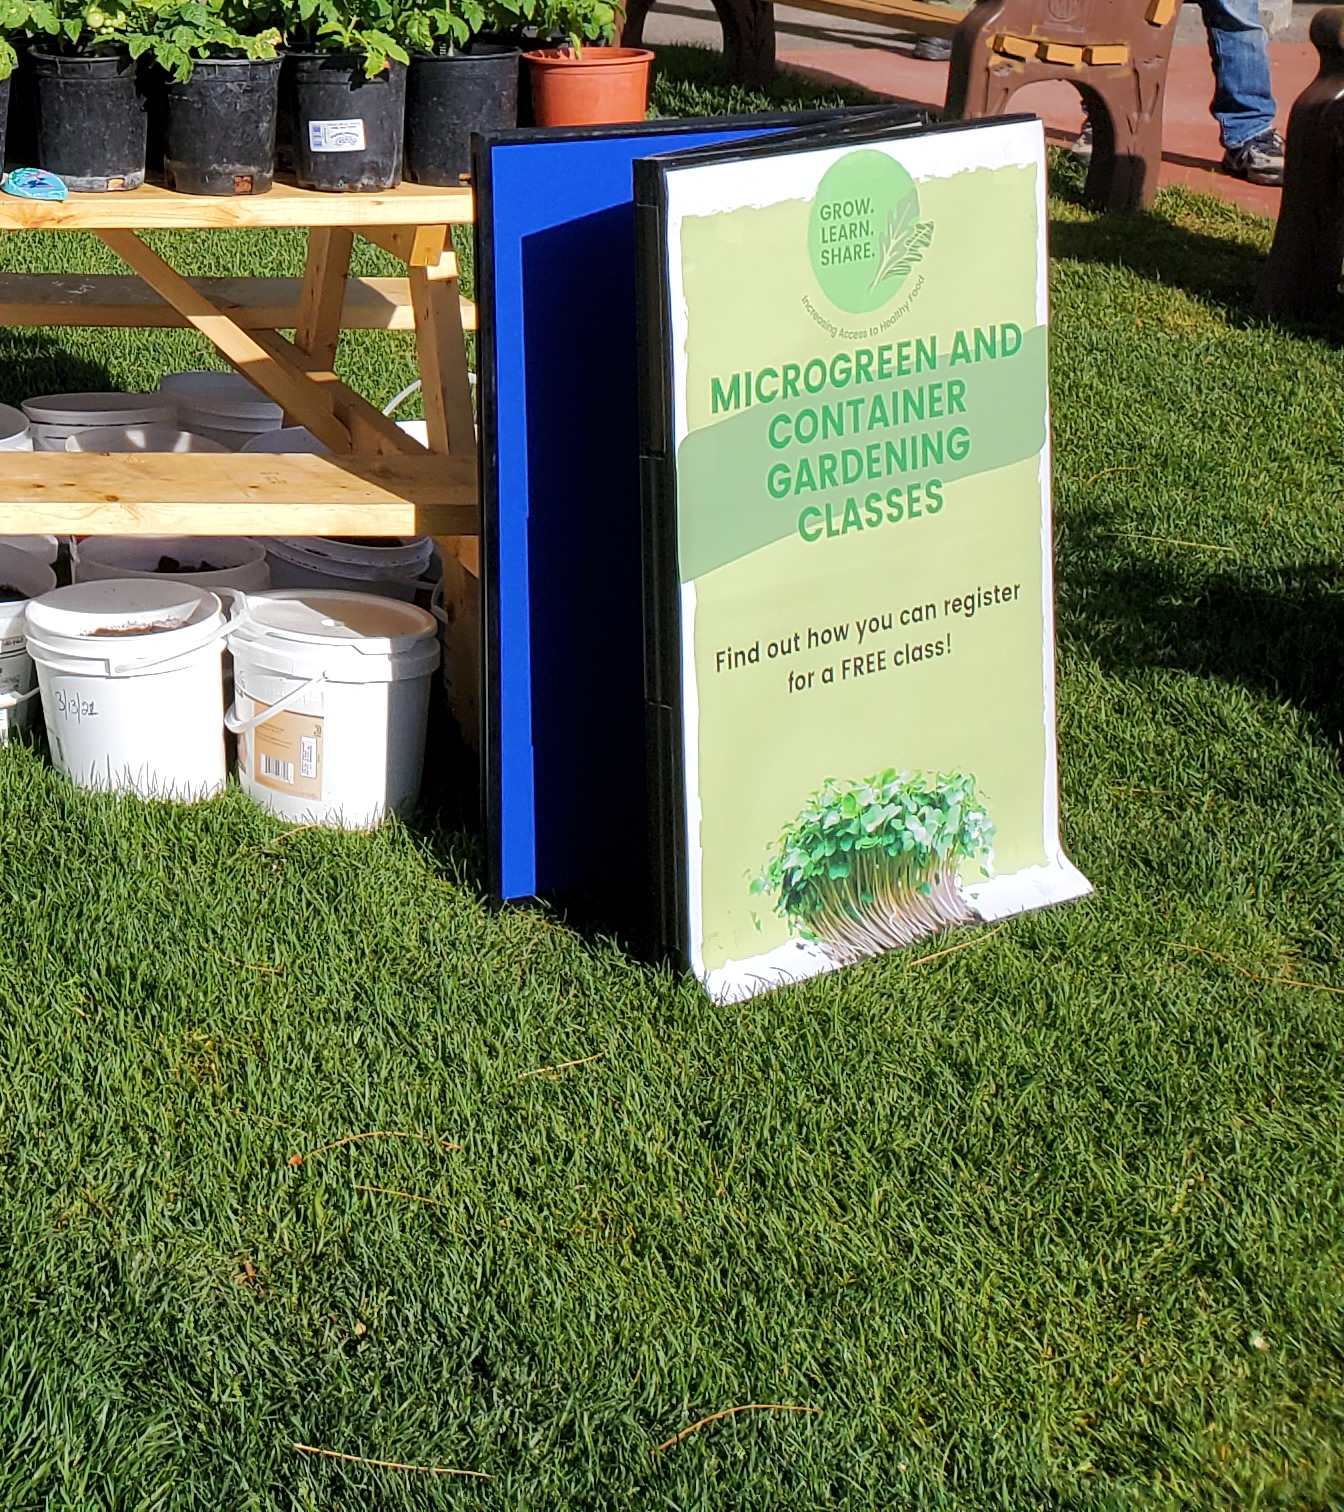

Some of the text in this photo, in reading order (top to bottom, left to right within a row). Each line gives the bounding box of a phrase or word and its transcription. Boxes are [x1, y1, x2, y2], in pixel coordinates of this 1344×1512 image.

[819, 197, 874, 221] GROW.
[821, 220, 874, 244] LEARN.
[820, 242, 875, 266] SHARE.
[801, 275, 926, 340] Increasing Access to Healthy Food
[710, 322, 1023, 415] MICROGREEN AND
[768, 378, 967, 450] CONTAINER
[766, 426, 971, 499] GARDENING
[797, 478, 944, 542] CLASSES
[715, 583, 1021, 673] Find out how you can register
[788, 632, 953, 694] for a FREE class!
[54, 688, 99, 725] 3/13/21
